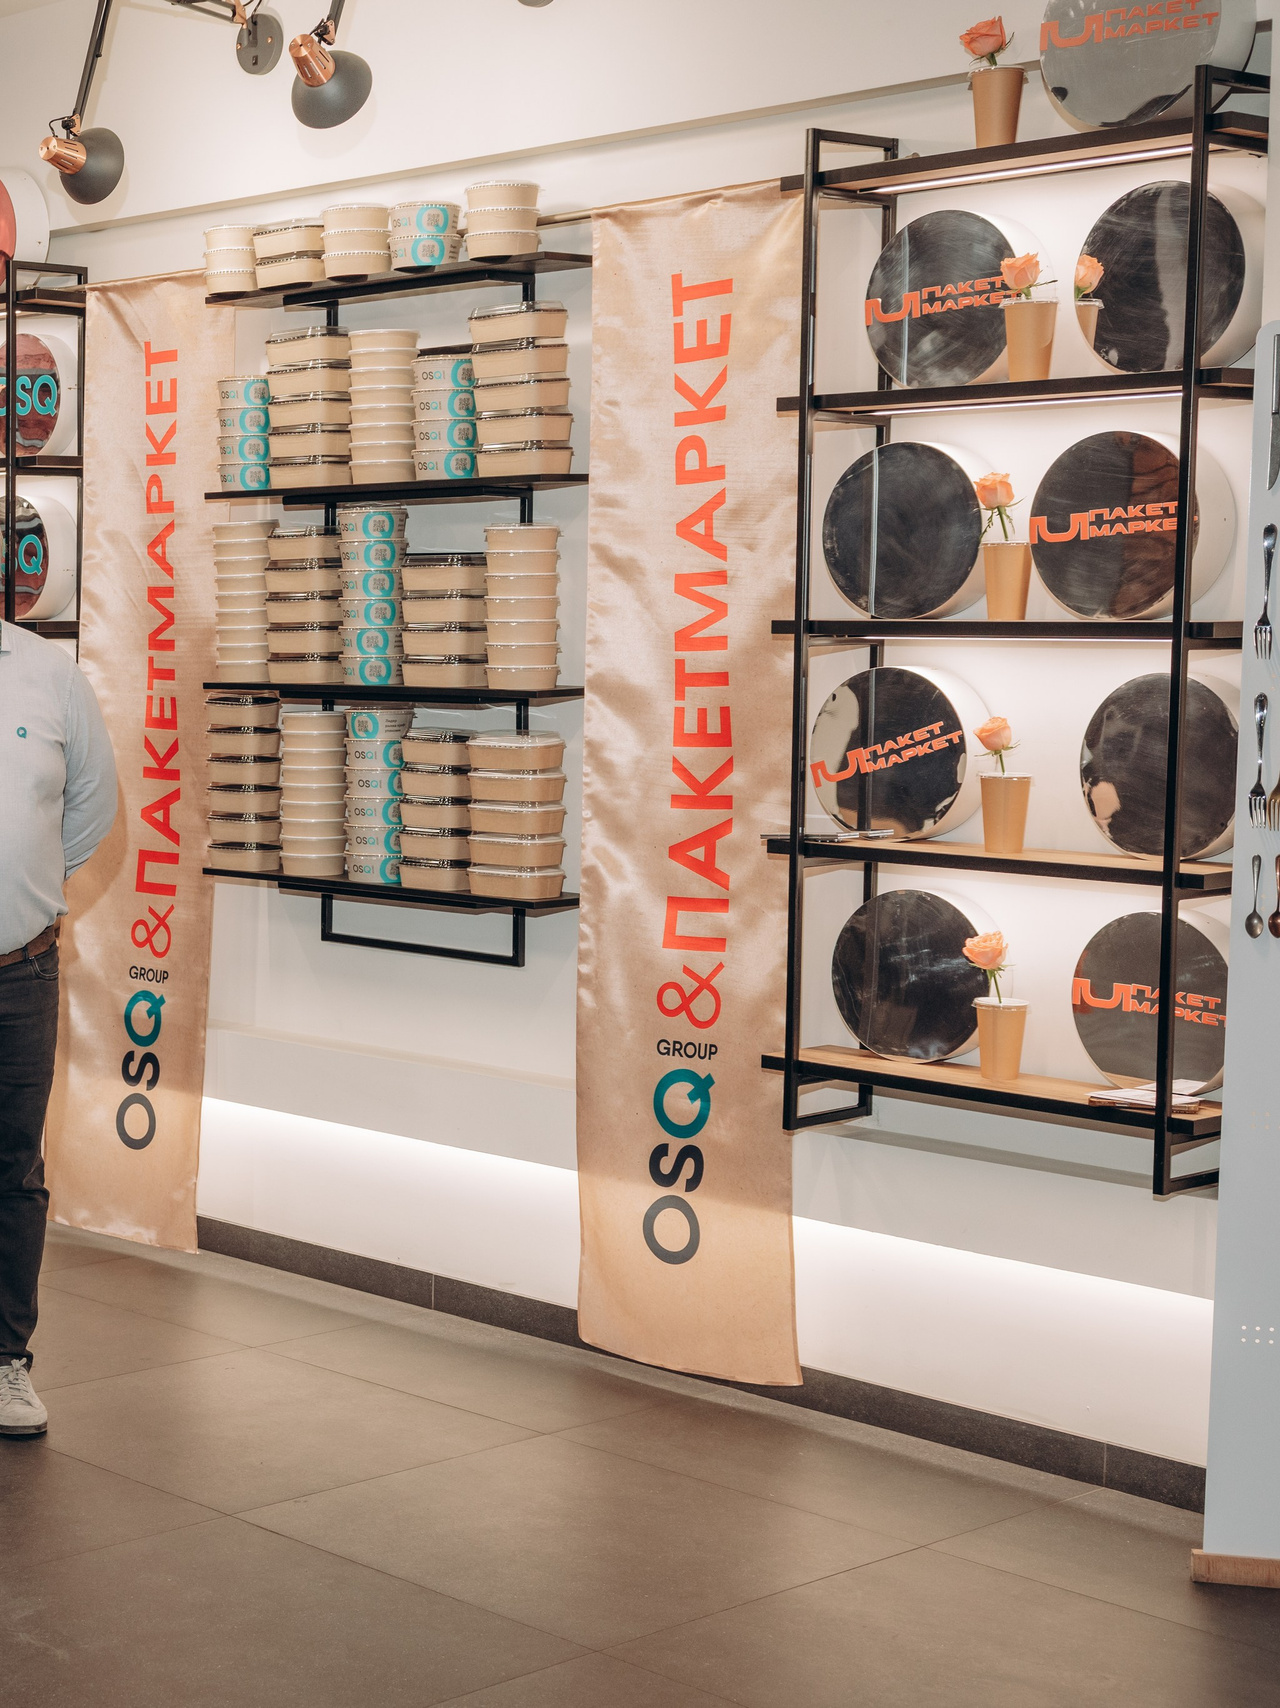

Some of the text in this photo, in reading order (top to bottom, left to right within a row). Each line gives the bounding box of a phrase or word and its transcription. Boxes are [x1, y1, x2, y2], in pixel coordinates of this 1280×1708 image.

[1104, 12, 1219, 39] МАРКЕТ
[1089, 501, 1178, 521] ПАКЕТ
[1089, 517, 1198, 538] МАРКЕ
[863, 721, 944, 759] ПАКЕТ
[354, 750, 374, 760] OSQ
[866, 730, 963, 773] МАРКЕТ
[357, 779, 379, 788] OSQ
[354, 807, 374, 817] OSQ
[355, 836, 376, 845] OSQ
[352, 864, 372, 874] OSQ
[128, 965, 170, 984] GROUP
[656, 1037, 719, 1061] GROUP
[115, 989, 166, 1151] OSQ
[642, 1068, 716, 1265] OSQ
